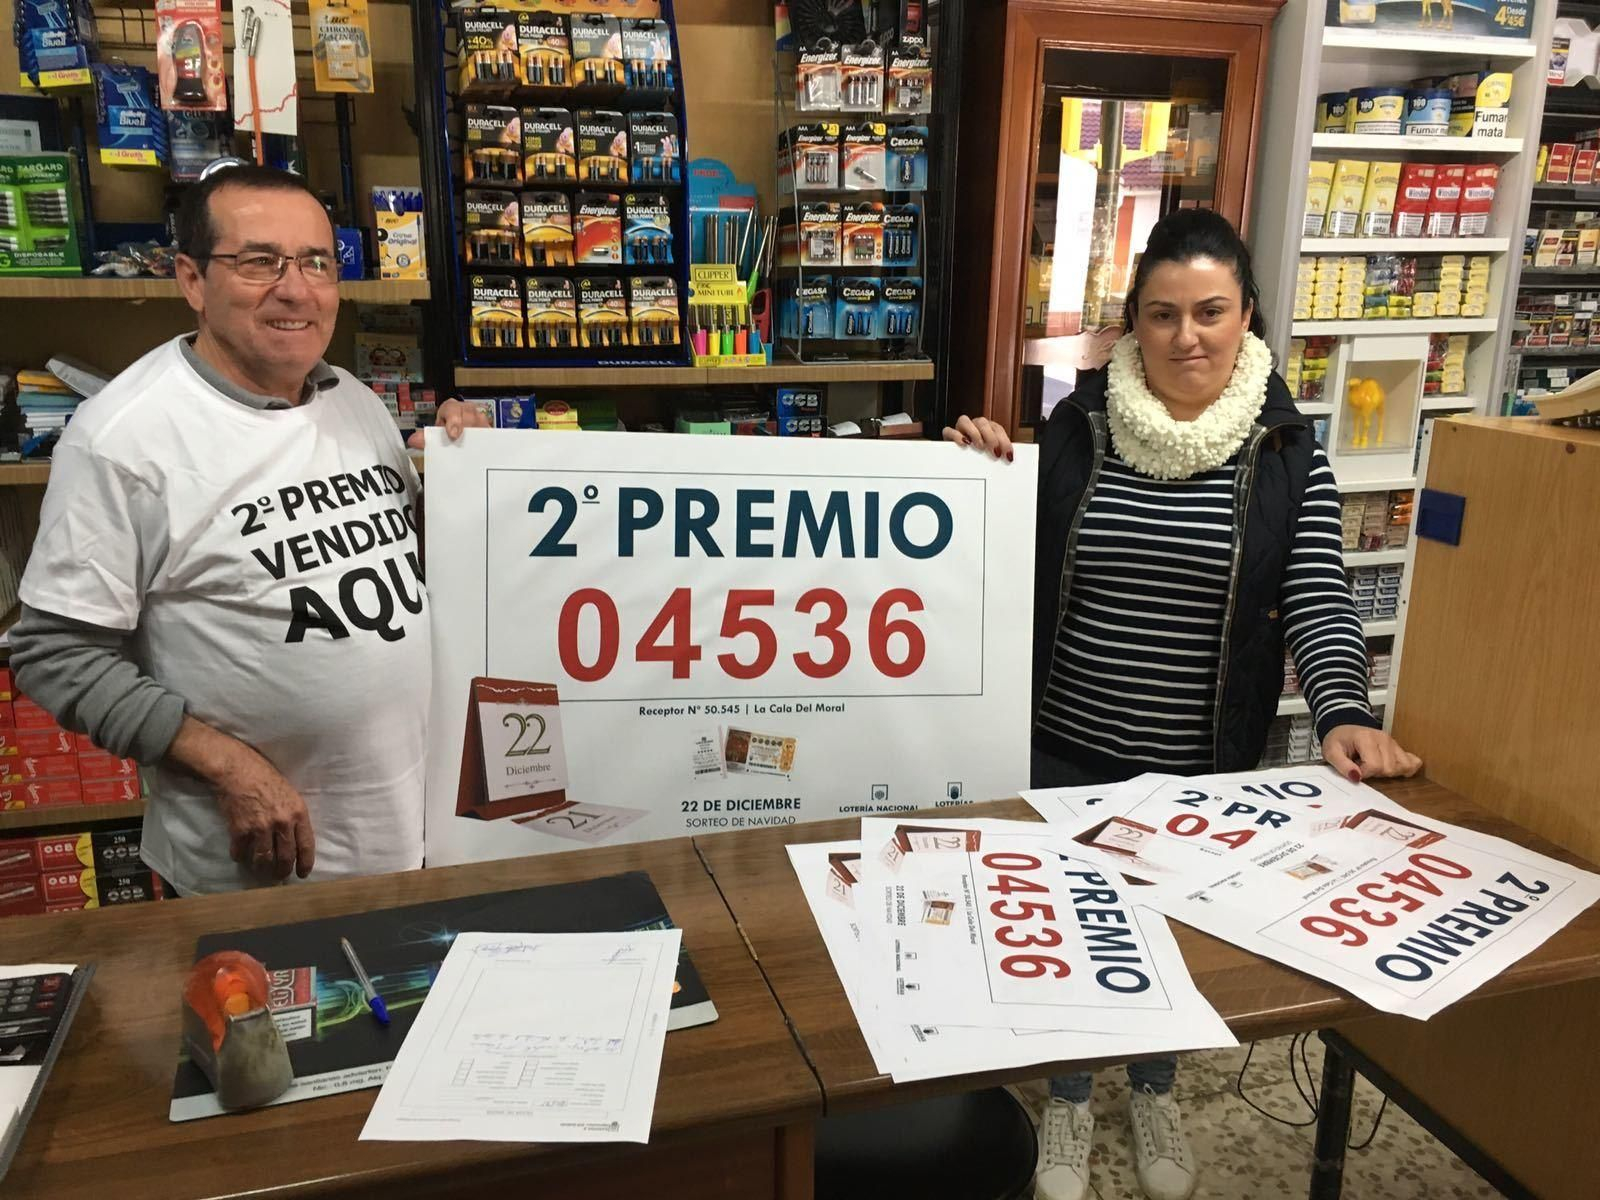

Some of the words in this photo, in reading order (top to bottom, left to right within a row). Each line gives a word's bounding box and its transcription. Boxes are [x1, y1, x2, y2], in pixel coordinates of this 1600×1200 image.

[464, 21, 504, 30] DURACELL
[520, 26, 566, 35] DURACELL
[572, 28, 610, 36] DURACELL
[623, 31, 659, 39] DURACELL
[800, 52, 838, 64] Energizer
[844, 55, 882, 66] Energizer
[892, 58, 930, 68] Energizer
[468, 118, 506, 128] DURACELL
[524, 122, 562, 130] DURACELL
[632, 124, 668, 132] DURACELL
[580, 125, 616, 134] DURACELL
[1410, 126, 1437, 134] Fumar
[1477, 127, 1502, 138] mata
[846, 134, 871, 142] Energizer
[890, 137, 924, 146] CEGASA
[466, 202, 504, 212] DURACELL
[580, 204, 617, 216] Energizer
[804, 212, 838, 223] Energizer
[846, 212, 880, 223] Energizer
[884, 214, 914, 223] CEGASA
[698, 271, 729, 280] CLIPPER
[474, 288, 518, 298] DURACELL
[582, 290, 624, 298] DURACELL
[632, 288, 676, 296] DURACELL
[843, 288, 874, 296] CEGASA
[885, 288, 916, 296] CEGASA
[782, 393, 818, 406] OCB
[786, 419, 822, 432] OCB
[231, 496, 274, 536] 2º
[278, 464, 406, 522] PREMIO
[527, 484, 600, 558] 2º
[618, 487, 954, 560] PREMIO
[558, 586, 926, 682] 04536
[638, 705, 686, 718] Receptor
[704, 704, 740, 715] 50.545
[754, 704, 767, 714] La
[768, 703, 792, 714] Cala
[795, 702, 812, 714] Del
[815, 702, 846, 713] Moral
[502, 712, 552, 757] 22
[506, 762, 552, 777] Diciembre
[680, 800, 698, 812] 22
[703, 800, 722, 812] DE
[724, 798, 801, 812] DICIEMBRE
[839, 804, 874, 813] LOTERÍA
[686, 816, 728, 828] SORTEO
[730, 816, 746, 827] DE
[748, 815, 796, 826] NAVIDAD
[44, 843, 74, 854] OCB
[103, 845, 140, 859] OCB
[48, 875, 78, 886] OCB
[1496, 871, 1550, 902] 2º
[108, 888, 144, 901] OCB
[1300, 853, 1472, 947] 04536
[981, 852, 1072, 980] 04536
[1064, 870, 1150, 994] PREMIO
[1375, 887, 1528, 982] PREMIO
